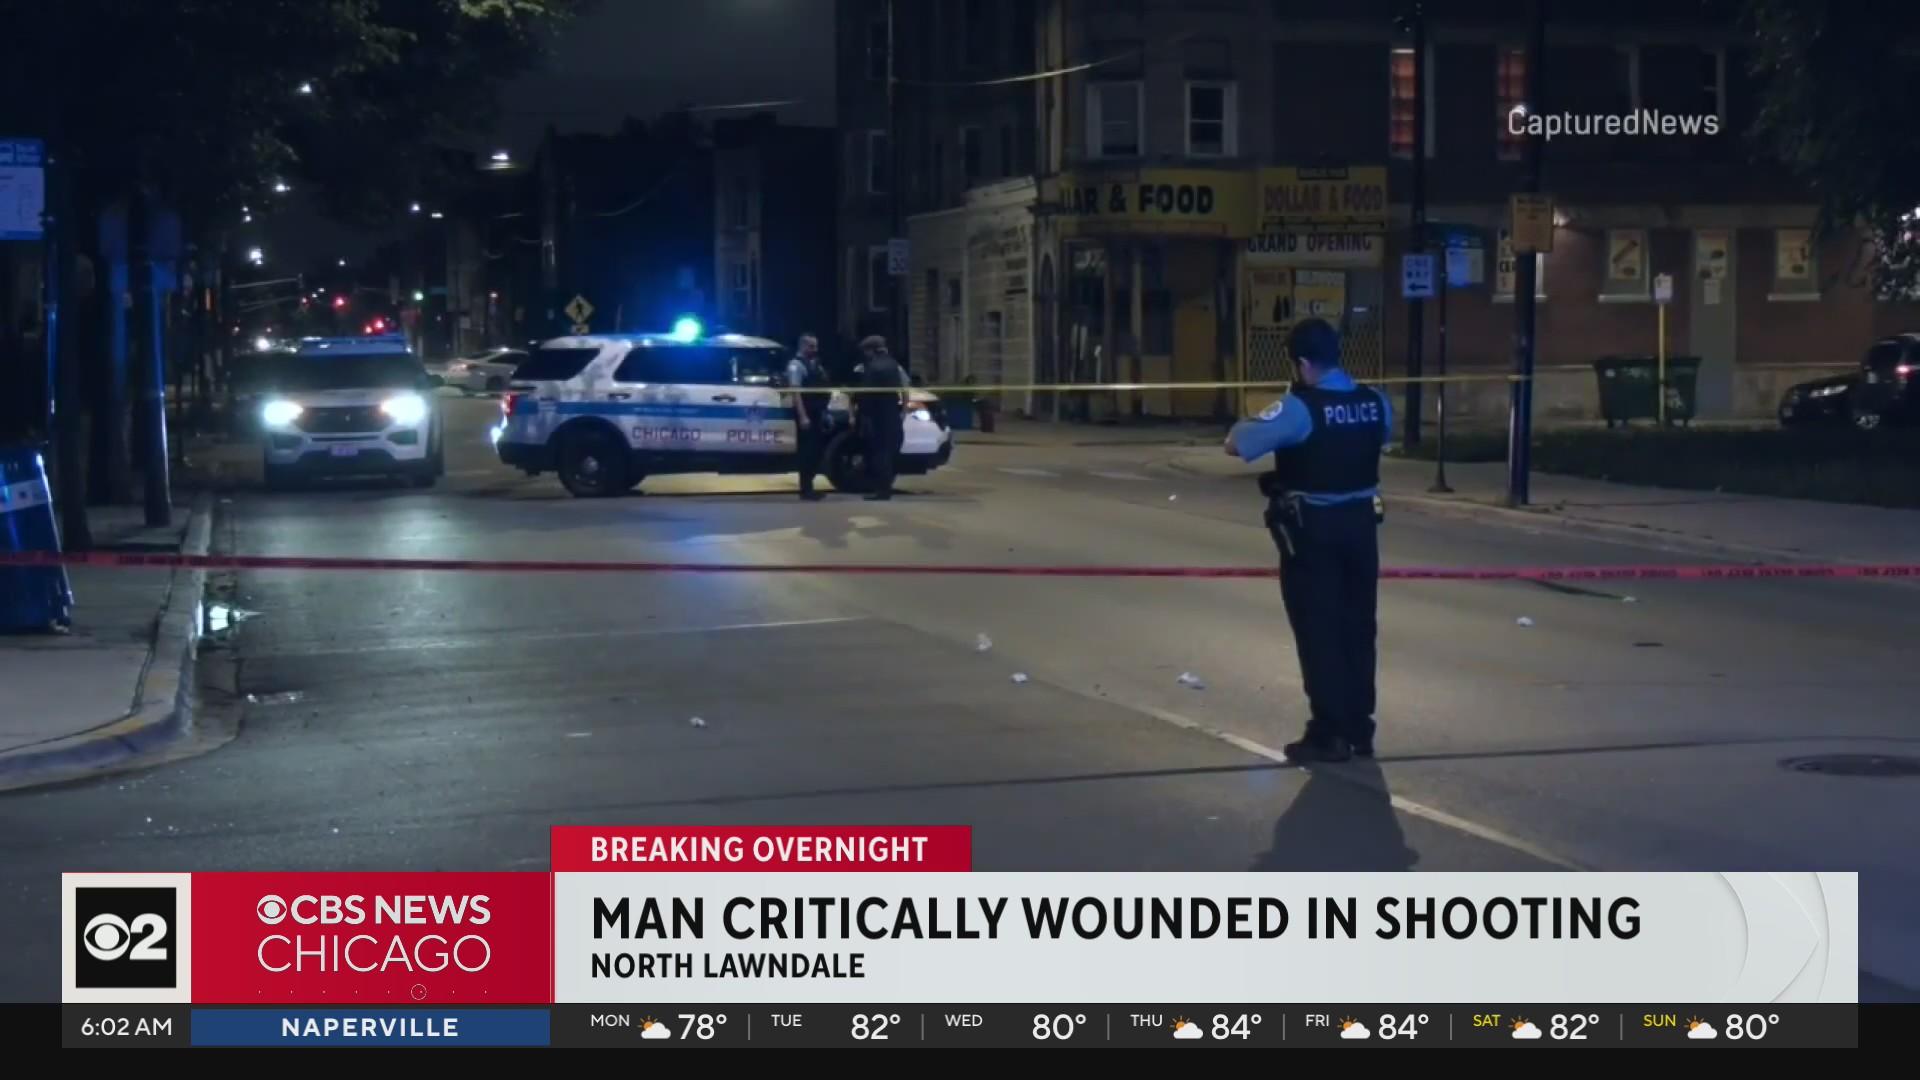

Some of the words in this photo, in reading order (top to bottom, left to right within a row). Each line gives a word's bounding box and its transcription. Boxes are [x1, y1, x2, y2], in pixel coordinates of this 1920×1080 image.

[1110, 184, 1126, 212] &
[1139, 184, 1214, 213] FOOD
[1264, 184, 1321, 211] DOLLAR
[1343, 183, 1383, 210] FOOD
[1248, 233, 1297, 252] GRAND
[1307, 233, 1372, 252] OPENING
[1323, 402, 1380, 426] POLICE
[631, 425, 703, 442] CHICAGO
[726, 428, 785, 444] POLICE
